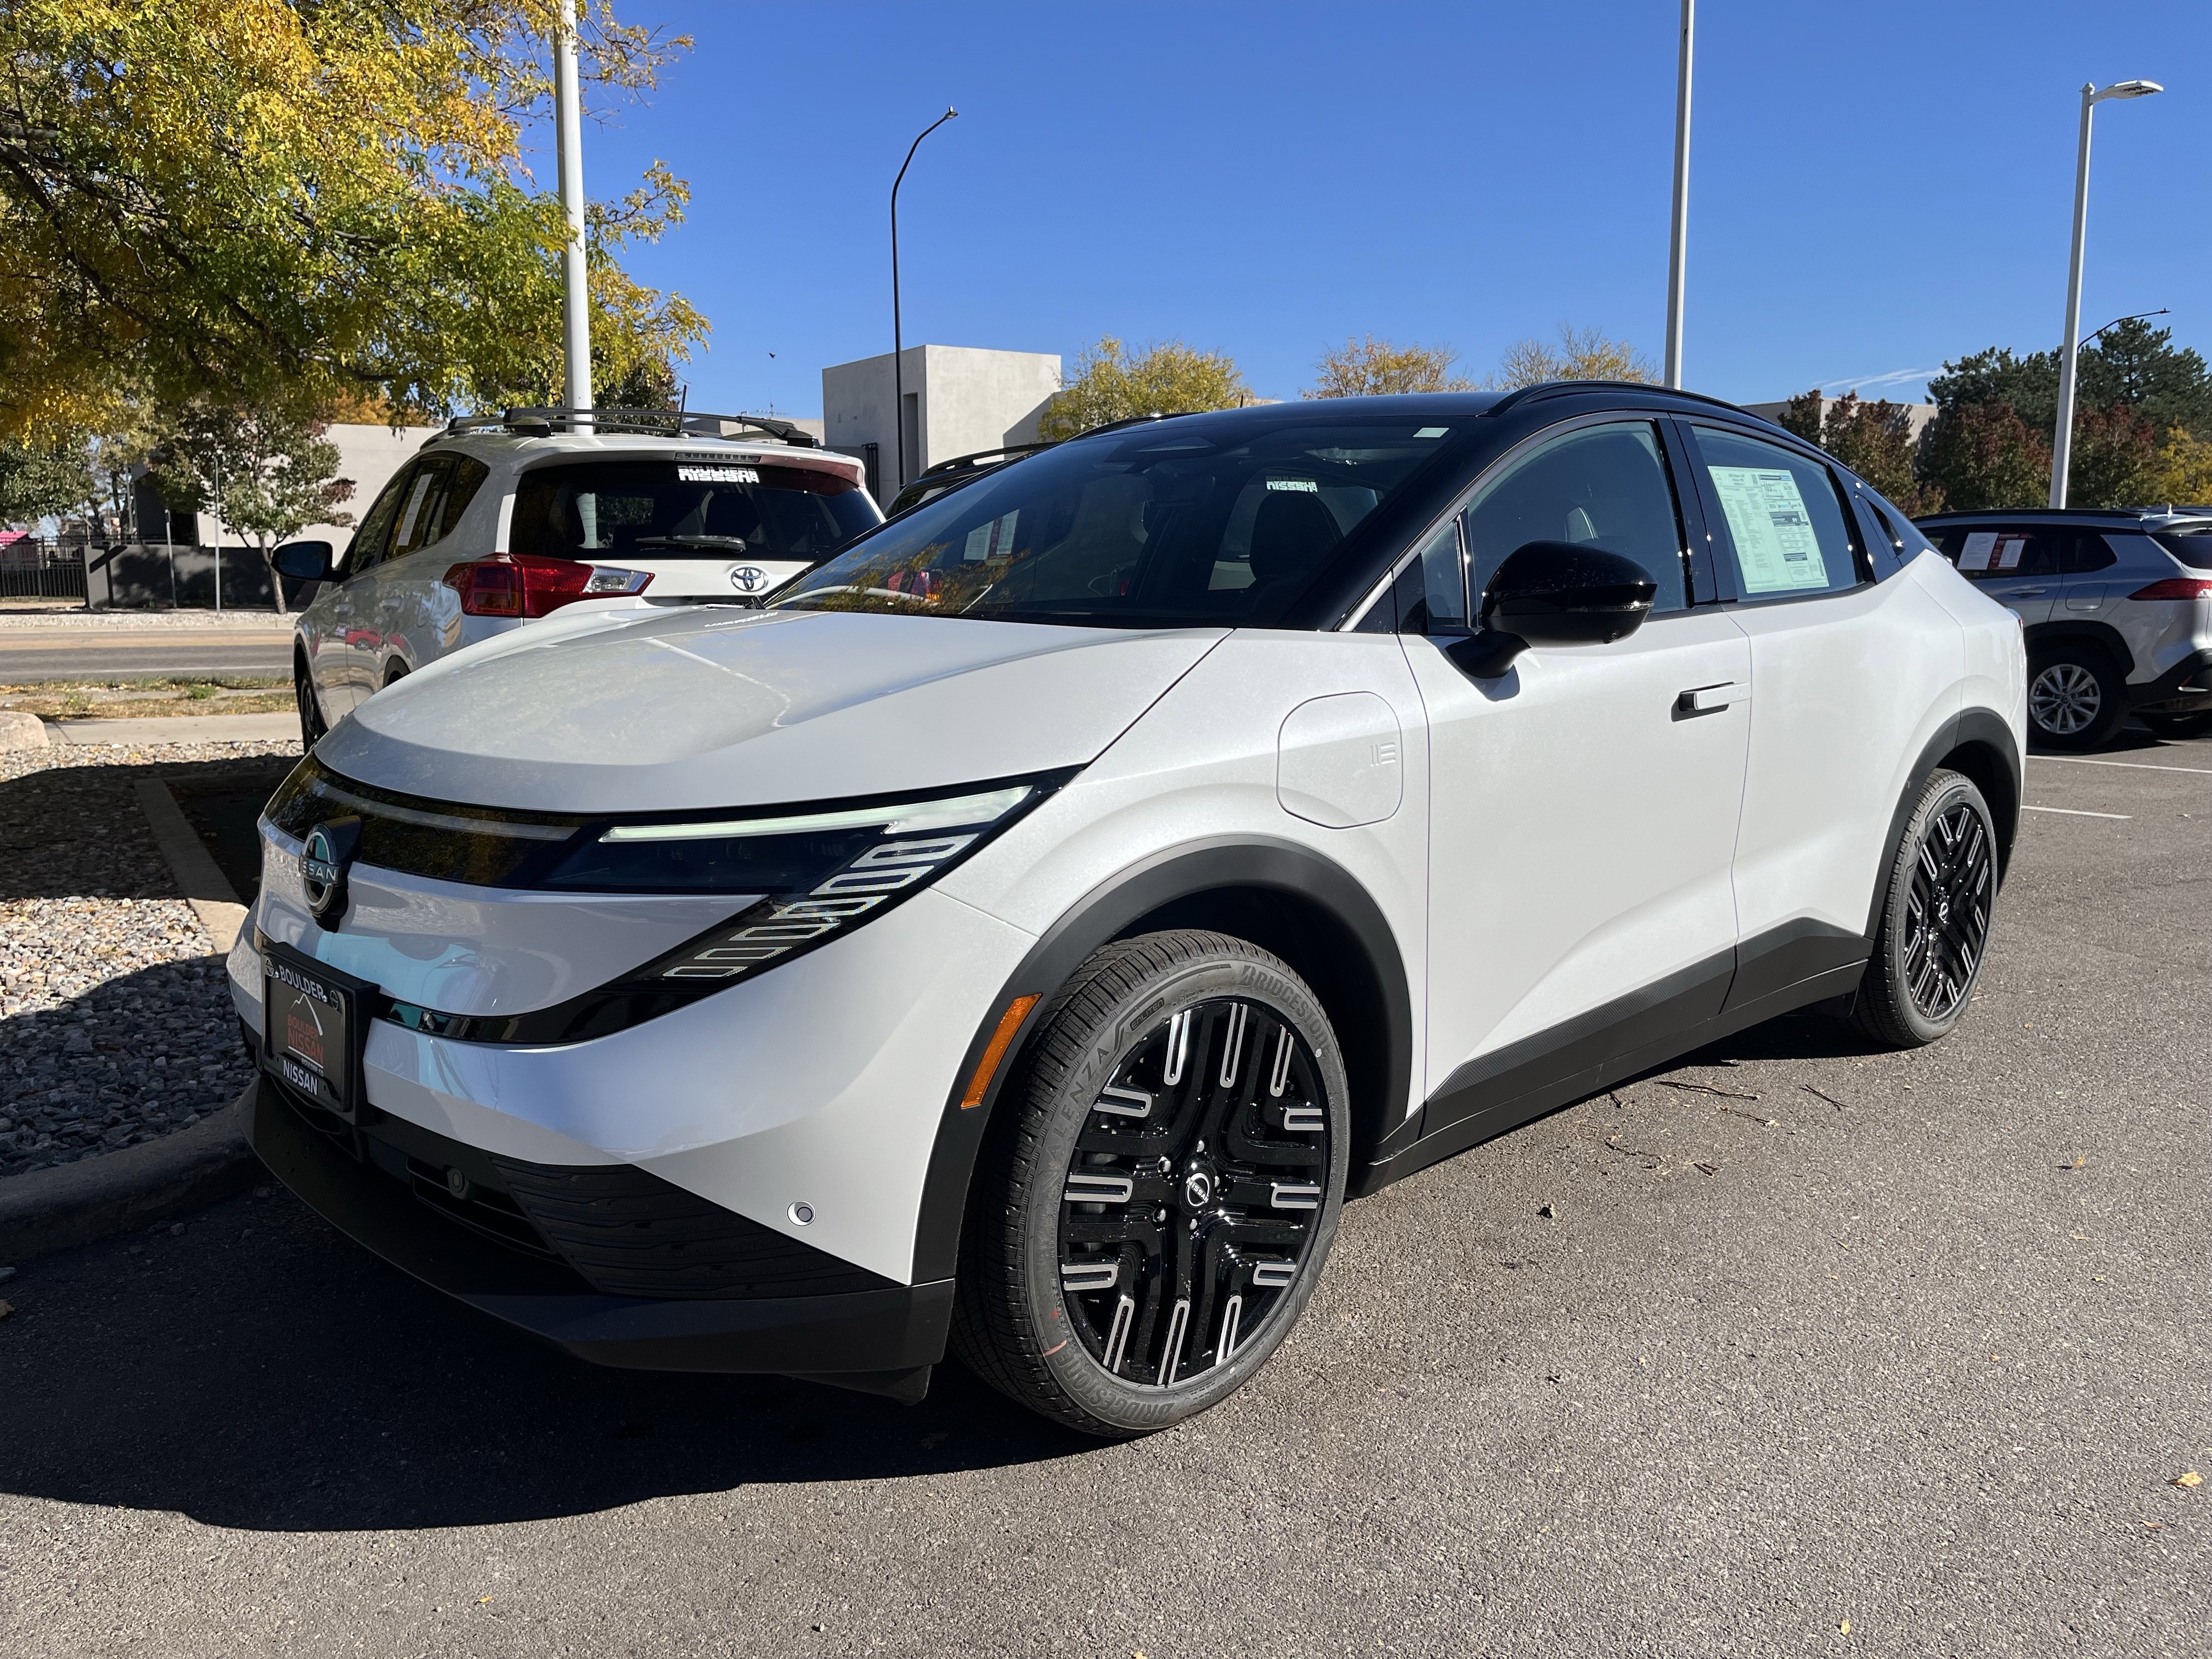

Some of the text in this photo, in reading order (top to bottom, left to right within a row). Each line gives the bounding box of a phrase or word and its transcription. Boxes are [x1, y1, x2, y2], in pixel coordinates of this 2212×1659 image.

[279, 964, 324, 1000] BOULDER
[287, 1014, 319, 1042] BOULDER
[1238, 964, 1331, 1057] BRIDGESTONE
[288, 1026, 324, 1065] NISSAN
[283, 1059, 317, 1096] NISSAN
[1186, 1176, 1209, 1203] NISSAN
